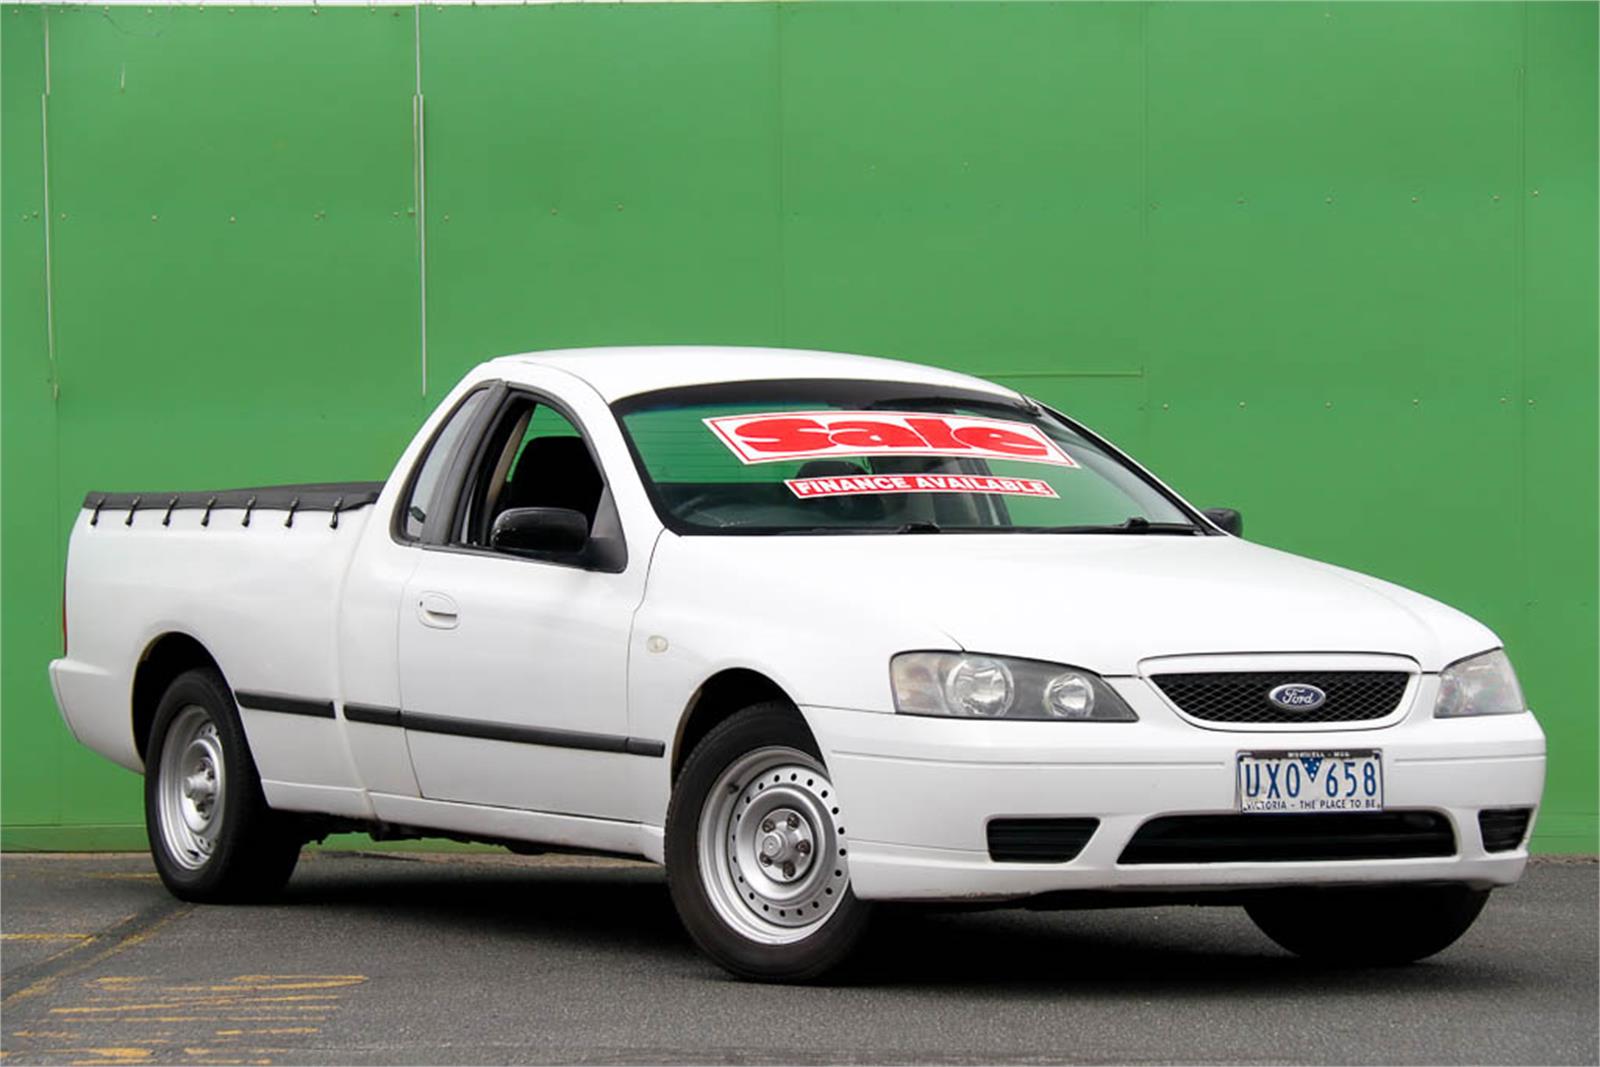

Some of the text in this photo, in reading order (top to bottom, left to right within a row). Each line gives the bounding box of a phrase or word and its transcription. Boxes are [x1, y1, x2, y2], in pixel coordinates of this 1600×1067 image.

[795, 476, 1052, 496] FINANCE AVAILABLE
[1282, 687, 1314, 704] Ford
[1245, 761, 1377, 799] UXO 658
[1300, 800, 1315, 810] THE
[1320, 799, 1346, 809] PLACE
[1350, 799, 1362, 809] TO
[1365, 798, 1376, 809] BE
